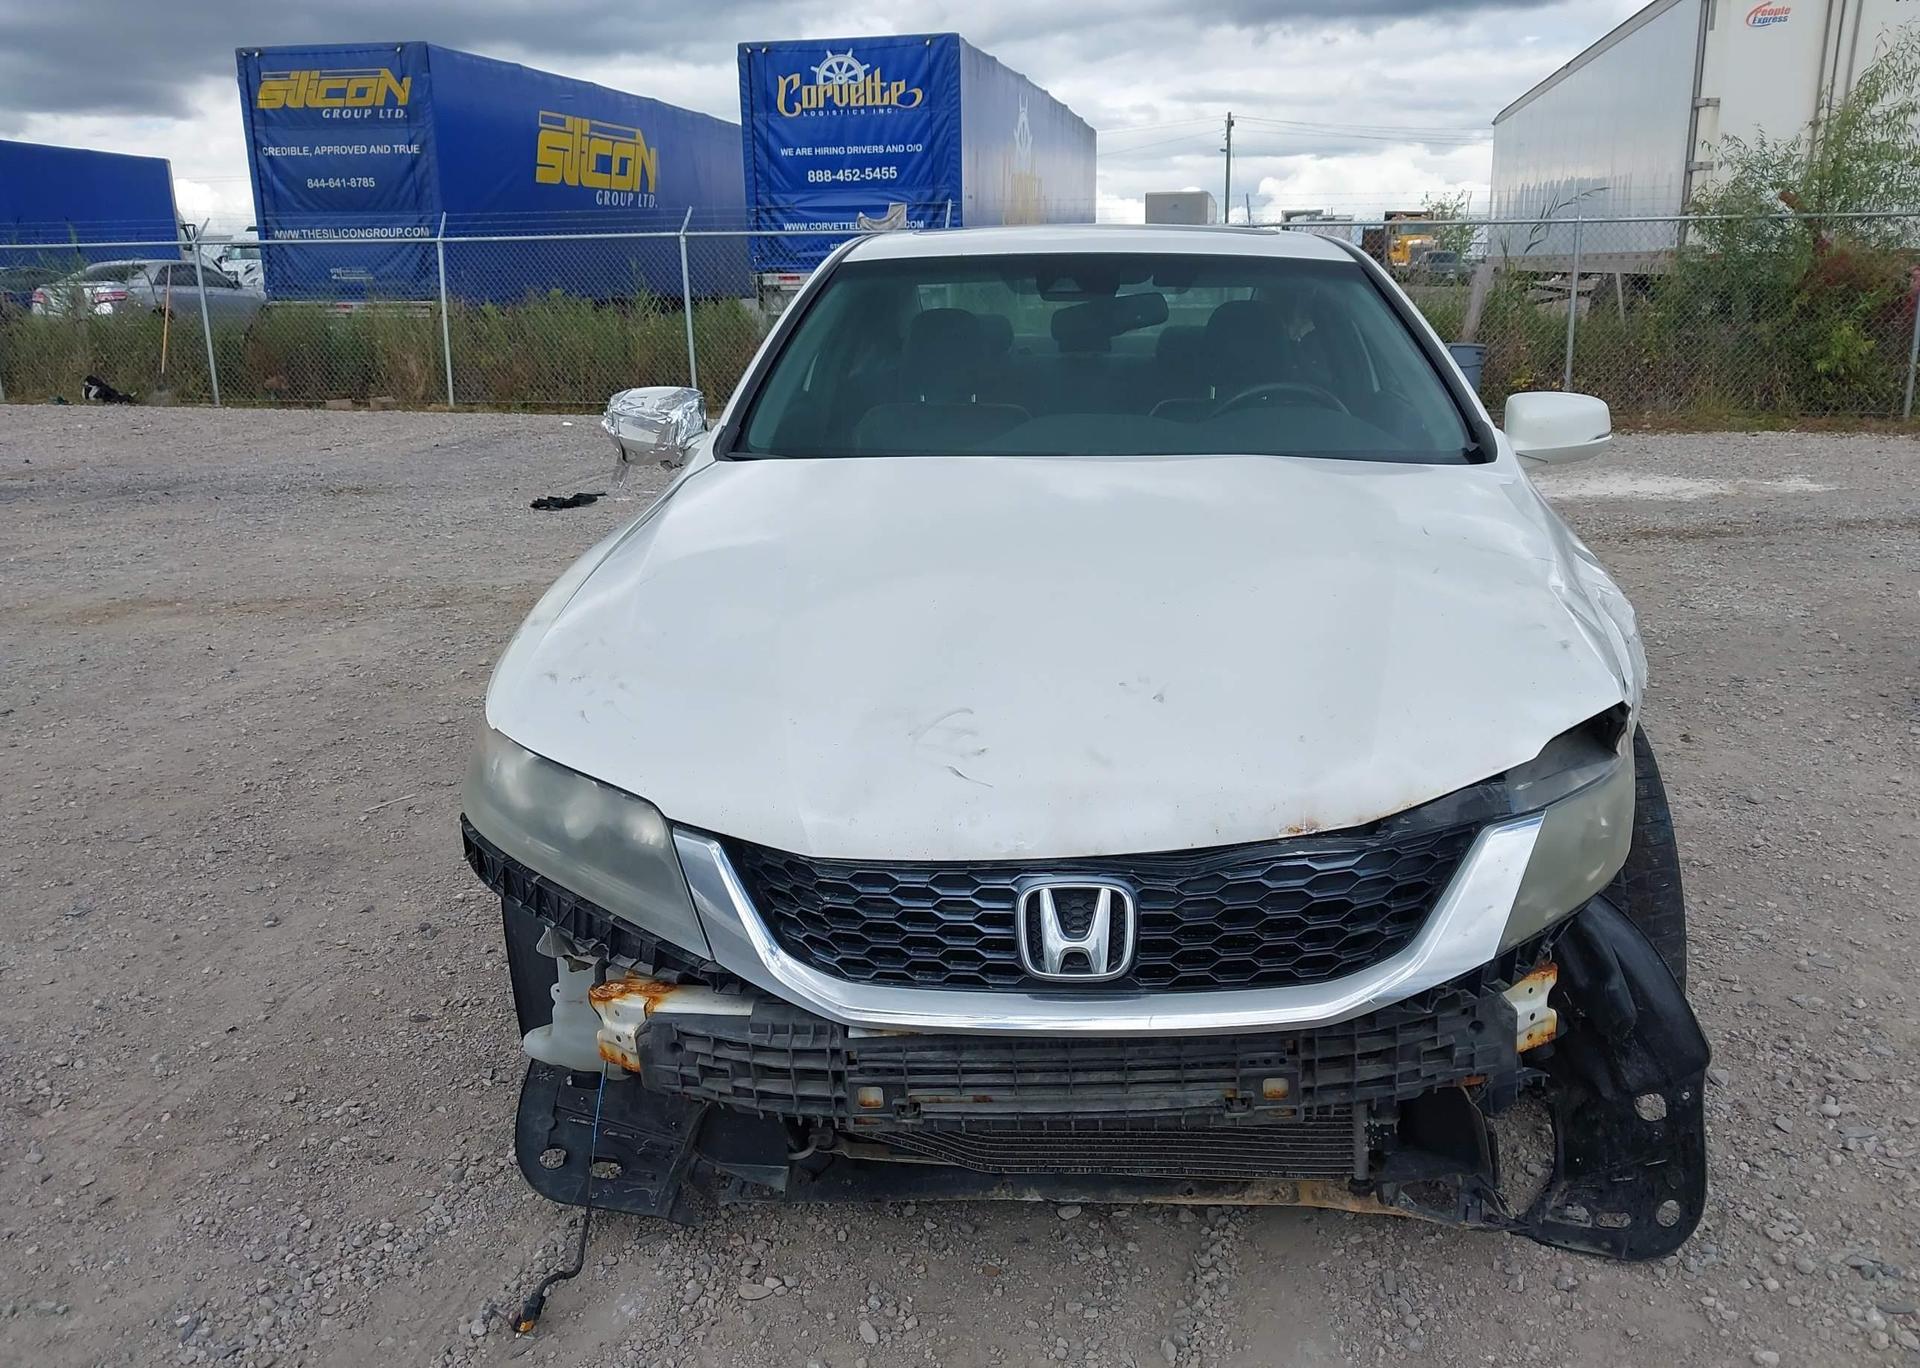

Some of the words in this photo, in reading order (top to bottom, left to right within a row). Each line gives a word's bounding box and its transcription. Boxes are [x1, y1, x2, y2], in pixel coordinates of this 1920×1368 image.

[1754, 6, 1791, 16] People
[1752, 16, 1788, 24] Express
[777, 67, 923, 117] Corvette
[322, 109, 372, 118] GROUP
[379, 109, 408, 118] LTD.
[803, 109, 866, 117] LOGISTICS
[262, 146, 312, 157] CREDIBLE,
[314, 145, 367, 155] APPROVED
[369, 145, 391, 154] AND
[393, 144, 420, 154] TRUE
[780, 148, 794, 156] WE
[795, 147, 813, 156] ARE
[815, 146, 845, 155] HIRING
[847, 145, 884, 154] DRIVERS
[886, 144, 905, 153] AND
[807, 167, 898, 182] 888-452-5455
[307, 178, 376, 188] 844-641-8785
[596, 190, 634, 206] GROUP
[638, 193, 658, 208] LTD.
[274, 227, 430, 239] WWW.THESILICONGROUP.COM
